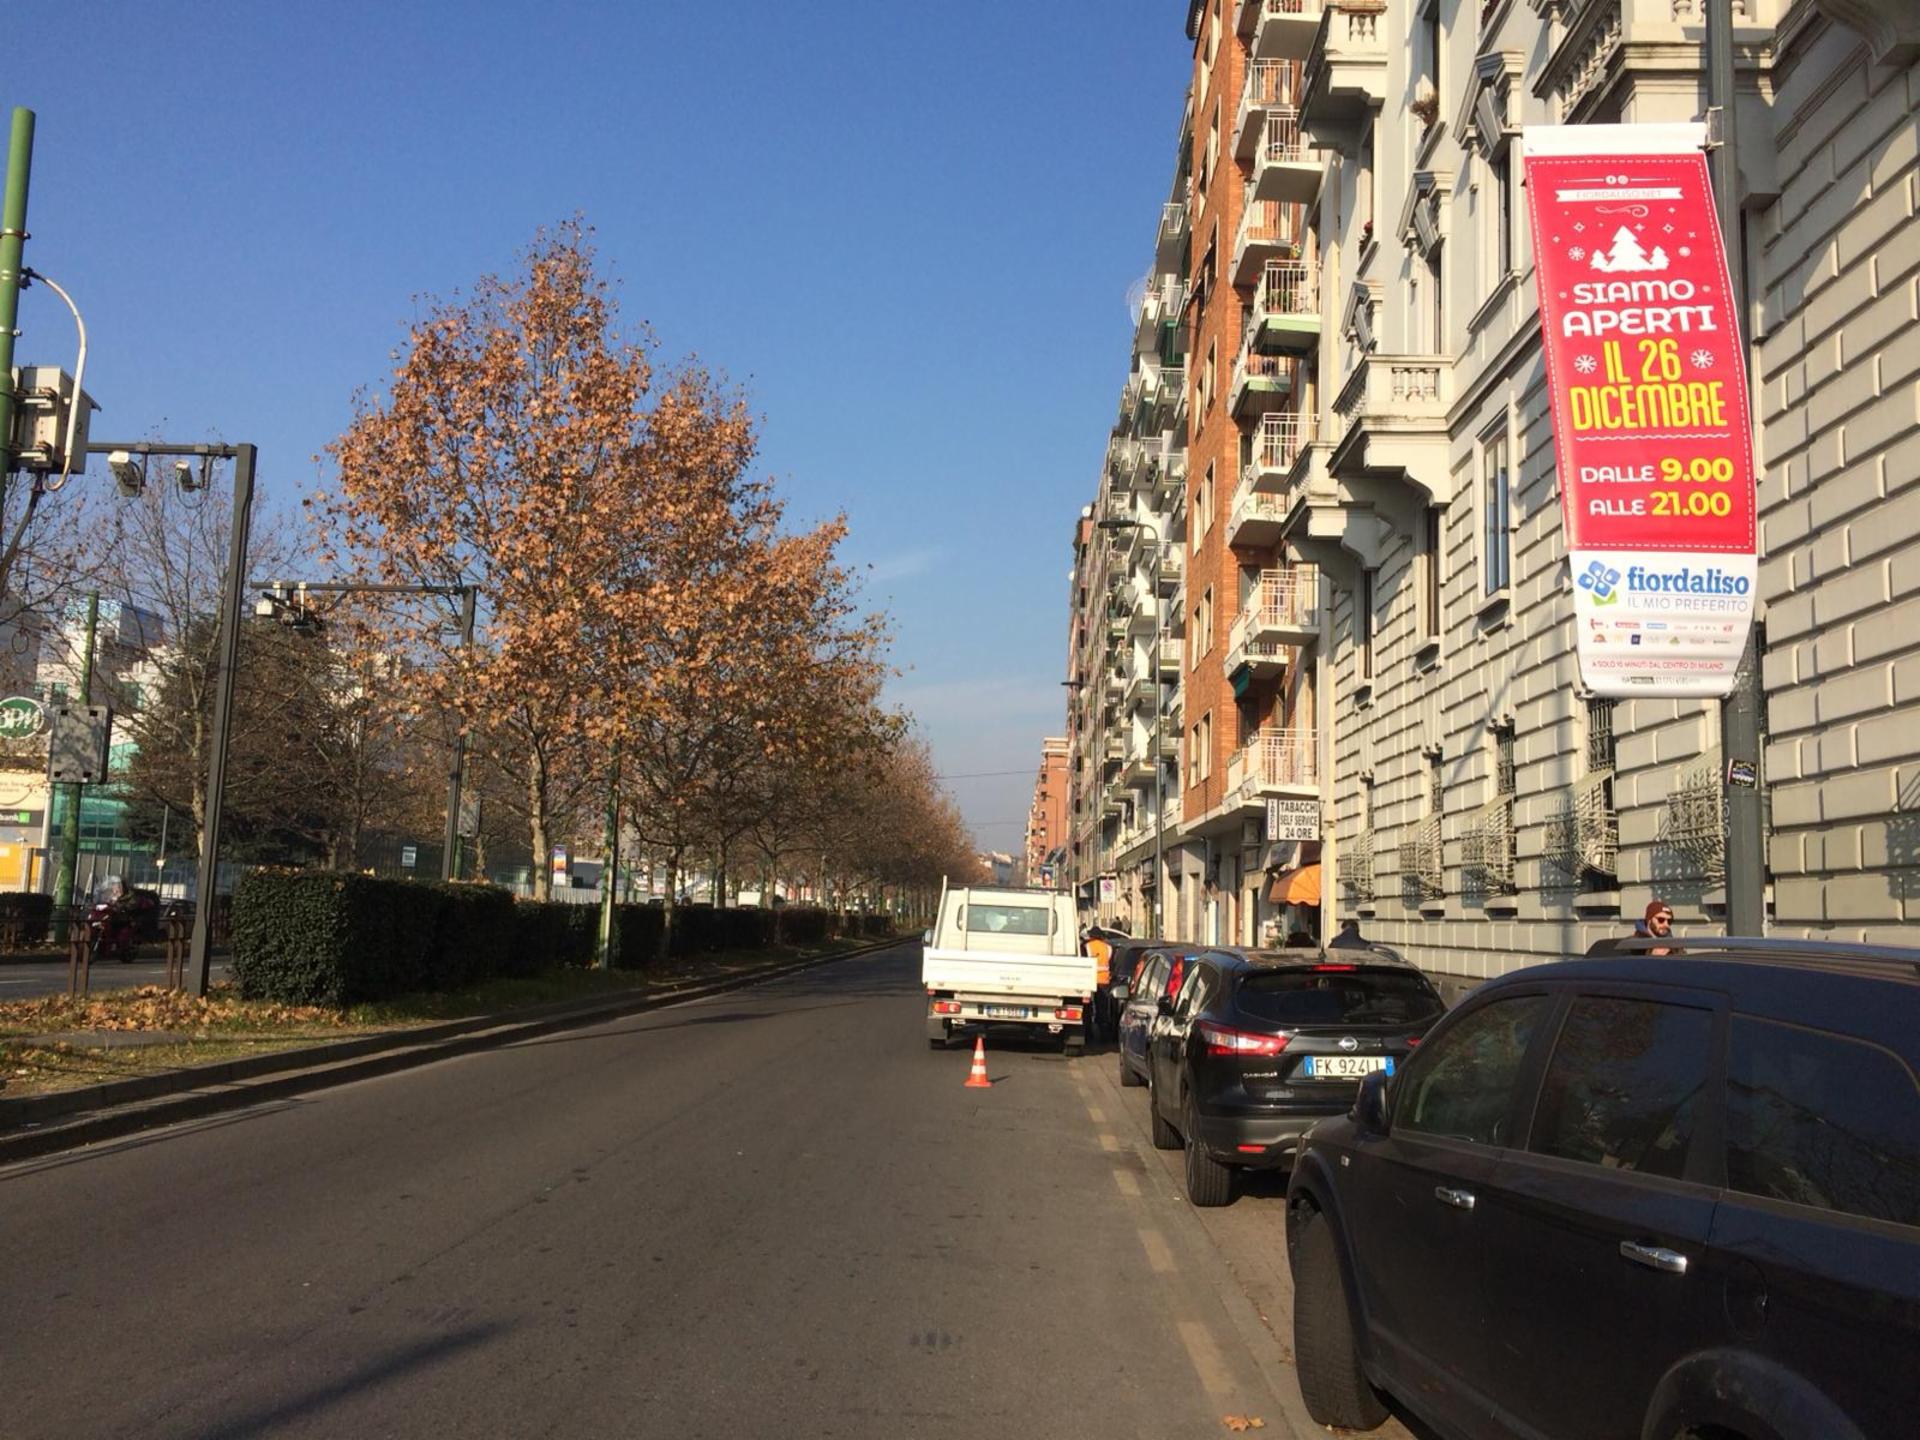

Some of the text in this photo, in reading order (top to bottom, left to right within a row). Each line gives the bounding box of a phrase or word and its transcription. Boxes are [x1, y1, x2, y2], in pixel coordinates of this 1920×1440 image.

[1573, 279, 1695, 305] SIAMO
[1562, 305, 1717, 337] APERTI
[1603, 338, 1682, 384] IL 26
[1570, 381, 1728, 430] DICEMBRE
[1580, 457, 1734, 483] DALLE 9.00
[1589, 491, 1731, 516] ALLE 21.00
[1627, 566, 1749, 595] fiordaliso
[1628, 597, 1748, 612] IL MIO PREFERITO
[1280, 801, 1318, 813] TABACCHI
[1280, 814, 1318, 827] SELF SERVICE
[1285, 827, 1294, 838] 24
[1296, 827, 1313, 839] ORE
[1315, 1058, 1333, 1074] FK
